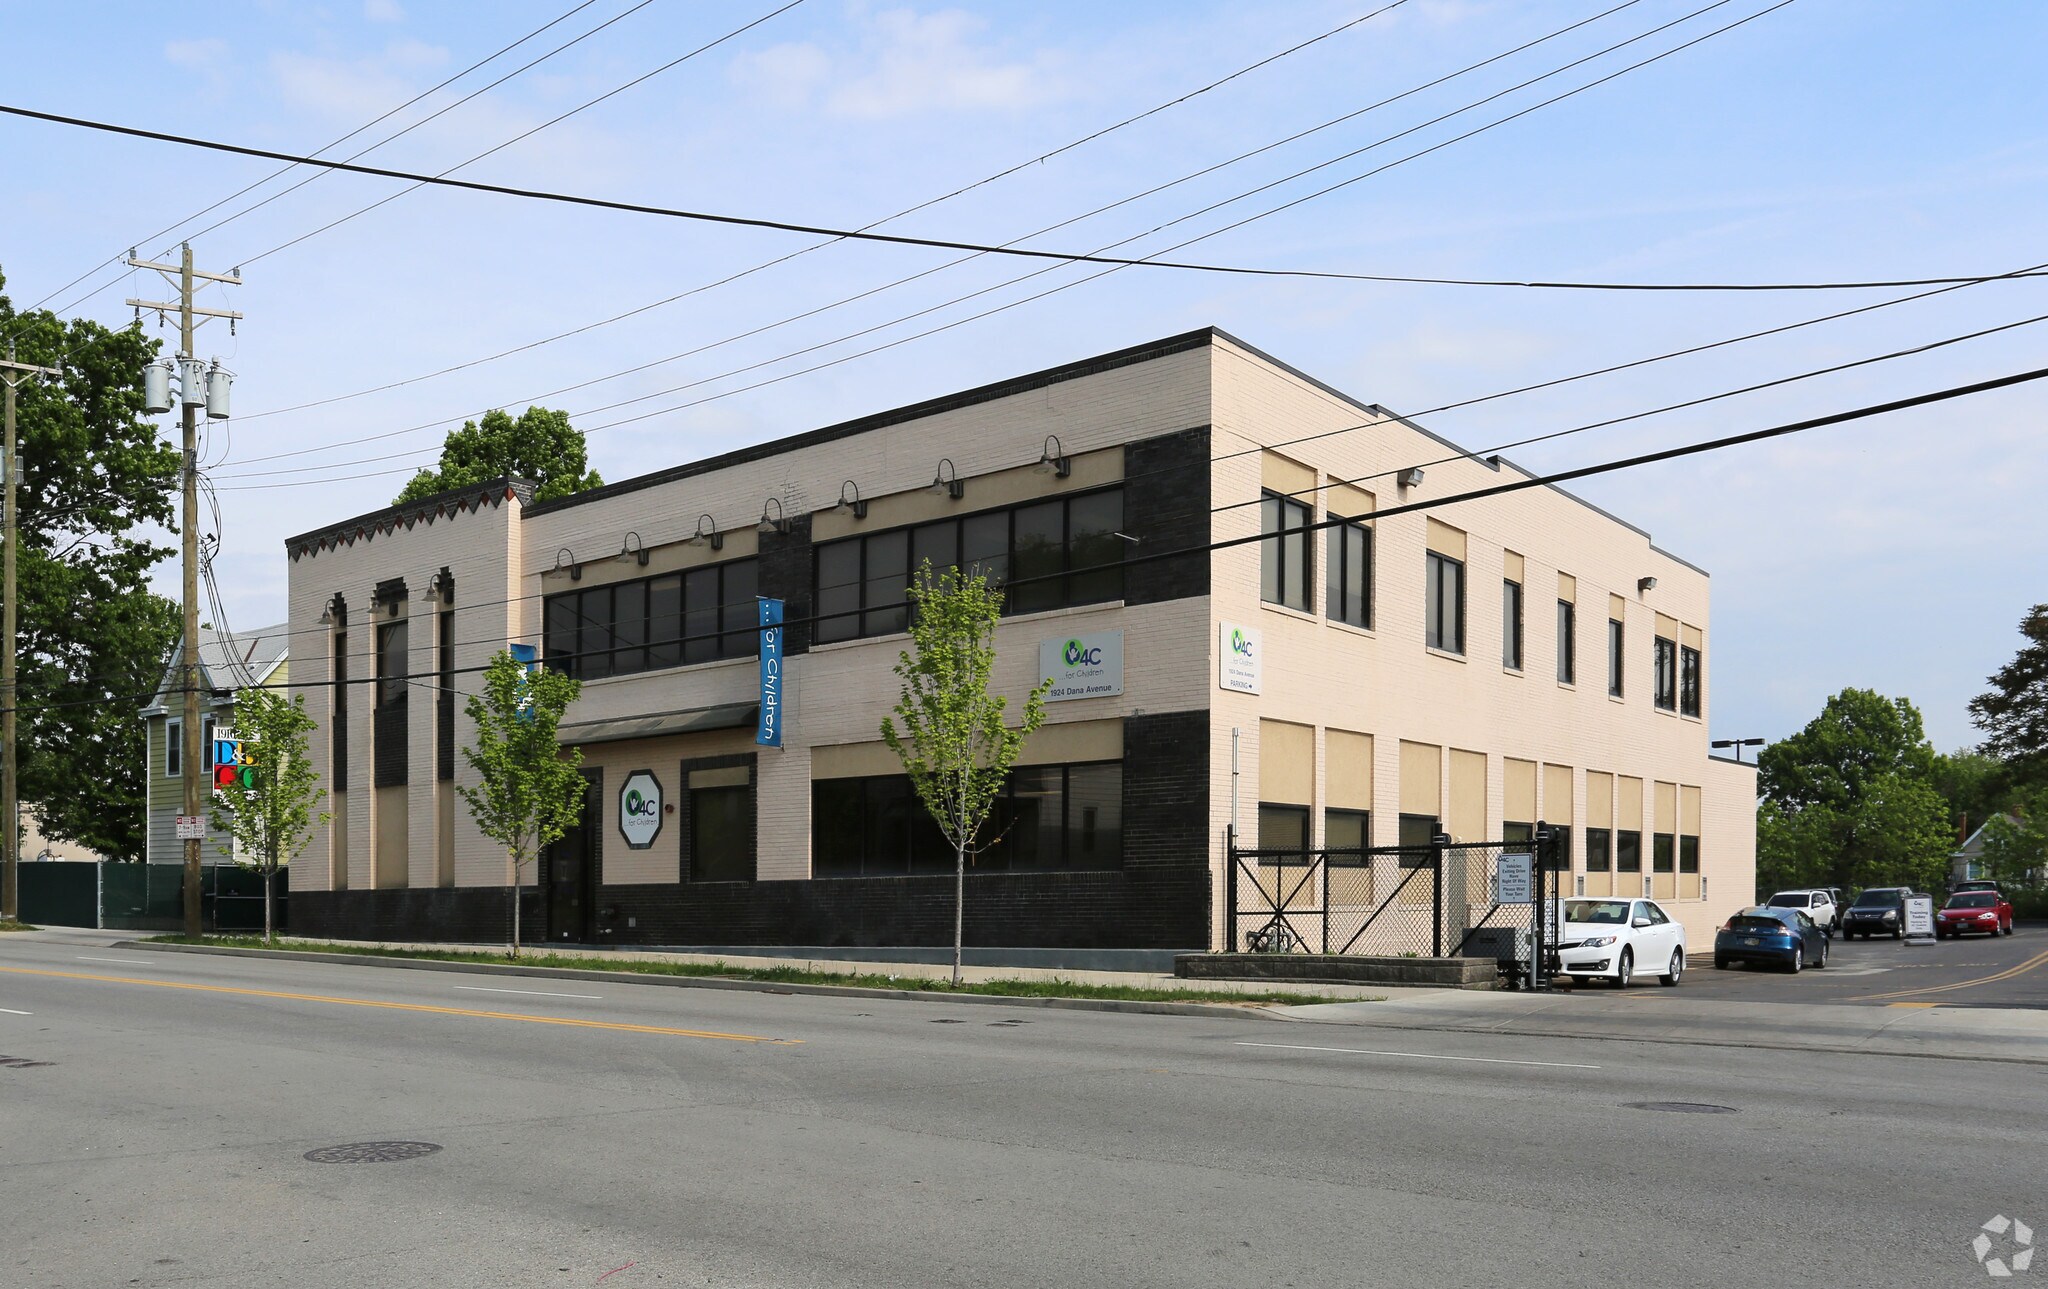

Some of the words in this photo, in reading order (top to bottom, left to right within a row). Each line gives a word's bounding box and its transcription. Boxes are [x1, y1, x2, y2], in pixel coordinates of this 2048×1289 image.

[1241, 640, 1253, 657] 4C
[1080, 648, 1102, 666] 4C
[1077, 669, 1104, 678] Children
[1086, 685, 1112, 693] Avenue
[1230, 680, 1248, 689] PARKING
[765, 658, 778, 740] Children
[639, 800, 655, 816] 4C
